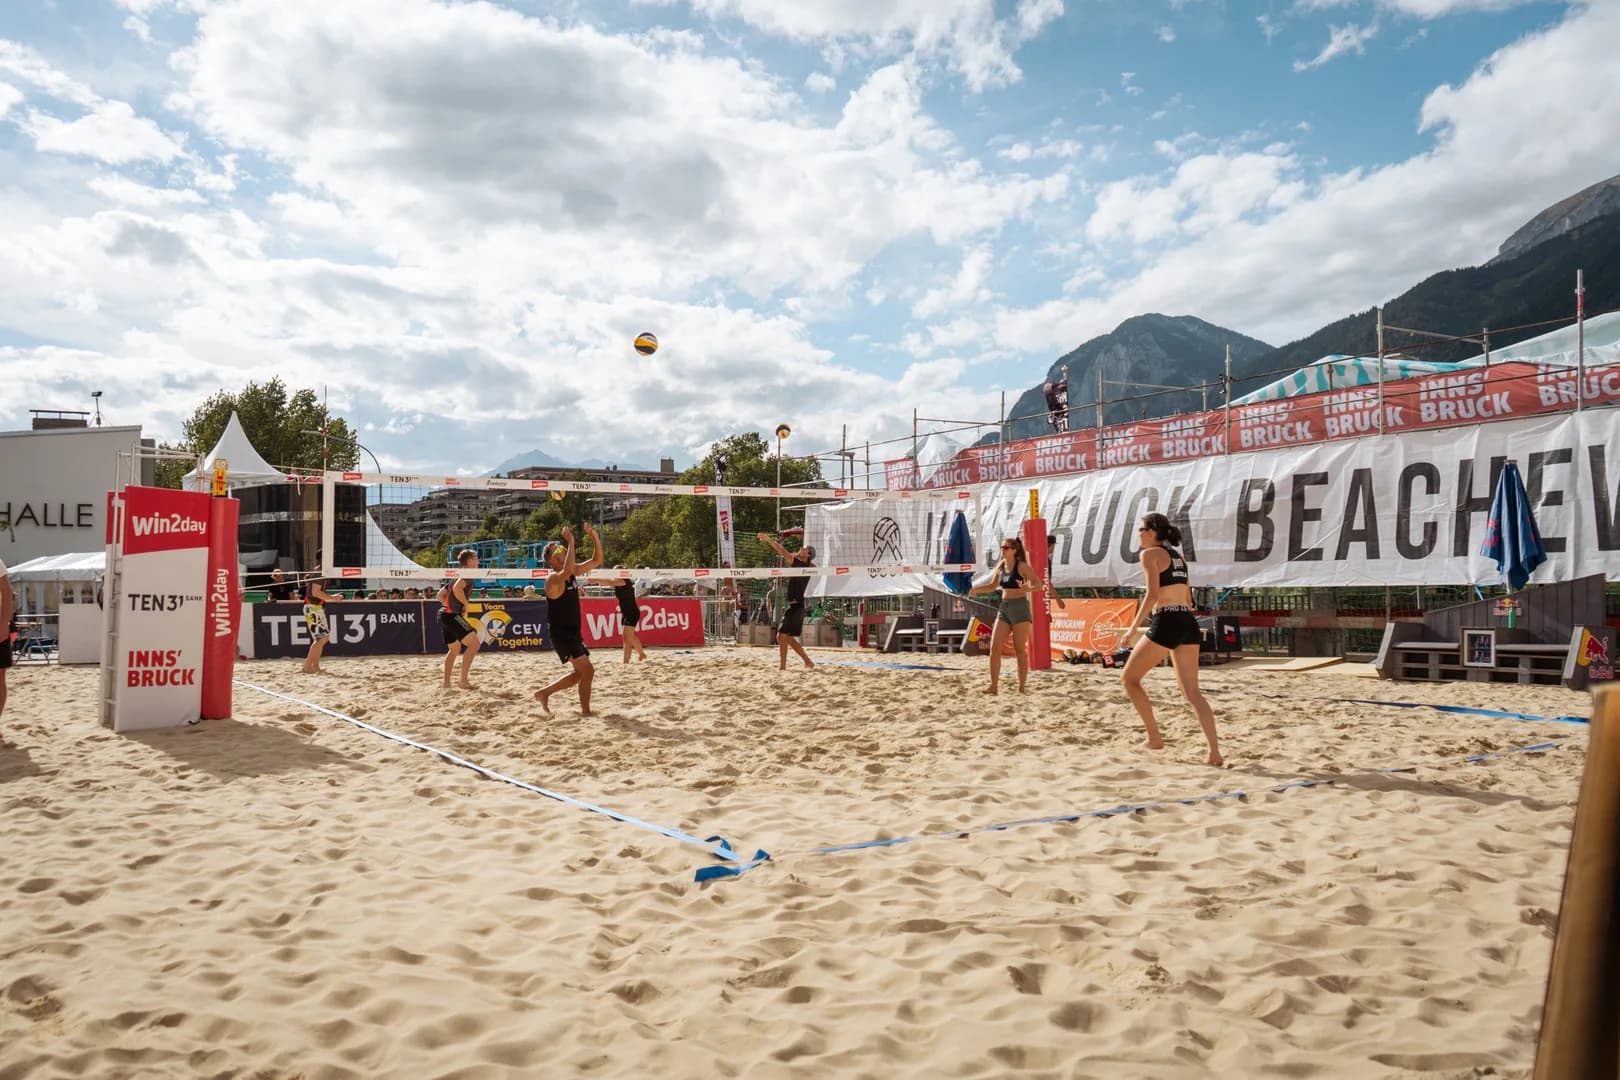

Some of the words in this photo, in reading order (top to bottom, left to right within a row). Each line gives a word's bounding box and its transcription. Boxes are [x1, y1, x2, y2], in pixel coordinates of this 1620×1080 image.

[1420, 391, 1512, 423] BRUCK
[1325, 406, 1405, 438] BRUCK
[1240, 420, 1313, 448] BRUCK
[1096, 443, 1152, 467] BRUCK
[1162, 434, 1224, 458] BRUCK
[979, 461, 1024, 481] BRUCK
[1035, 453, 1087, 474] BRUCK
[933, 468, 971, 488] BRUCK
[132, 512, 207, 536] win2day
[210, 568, 232, 637] win2day
[483, 603, 505, 611] Years
[380, 613, 416, 624] BANK
[586, 605, 690, 641] wi2day
[512, 623, 542, 636] CEV
[498, 635, 544, 649] Together
[128, 649, 182, 668] INNS'
[127, 668, 196, 688] BRUCK
